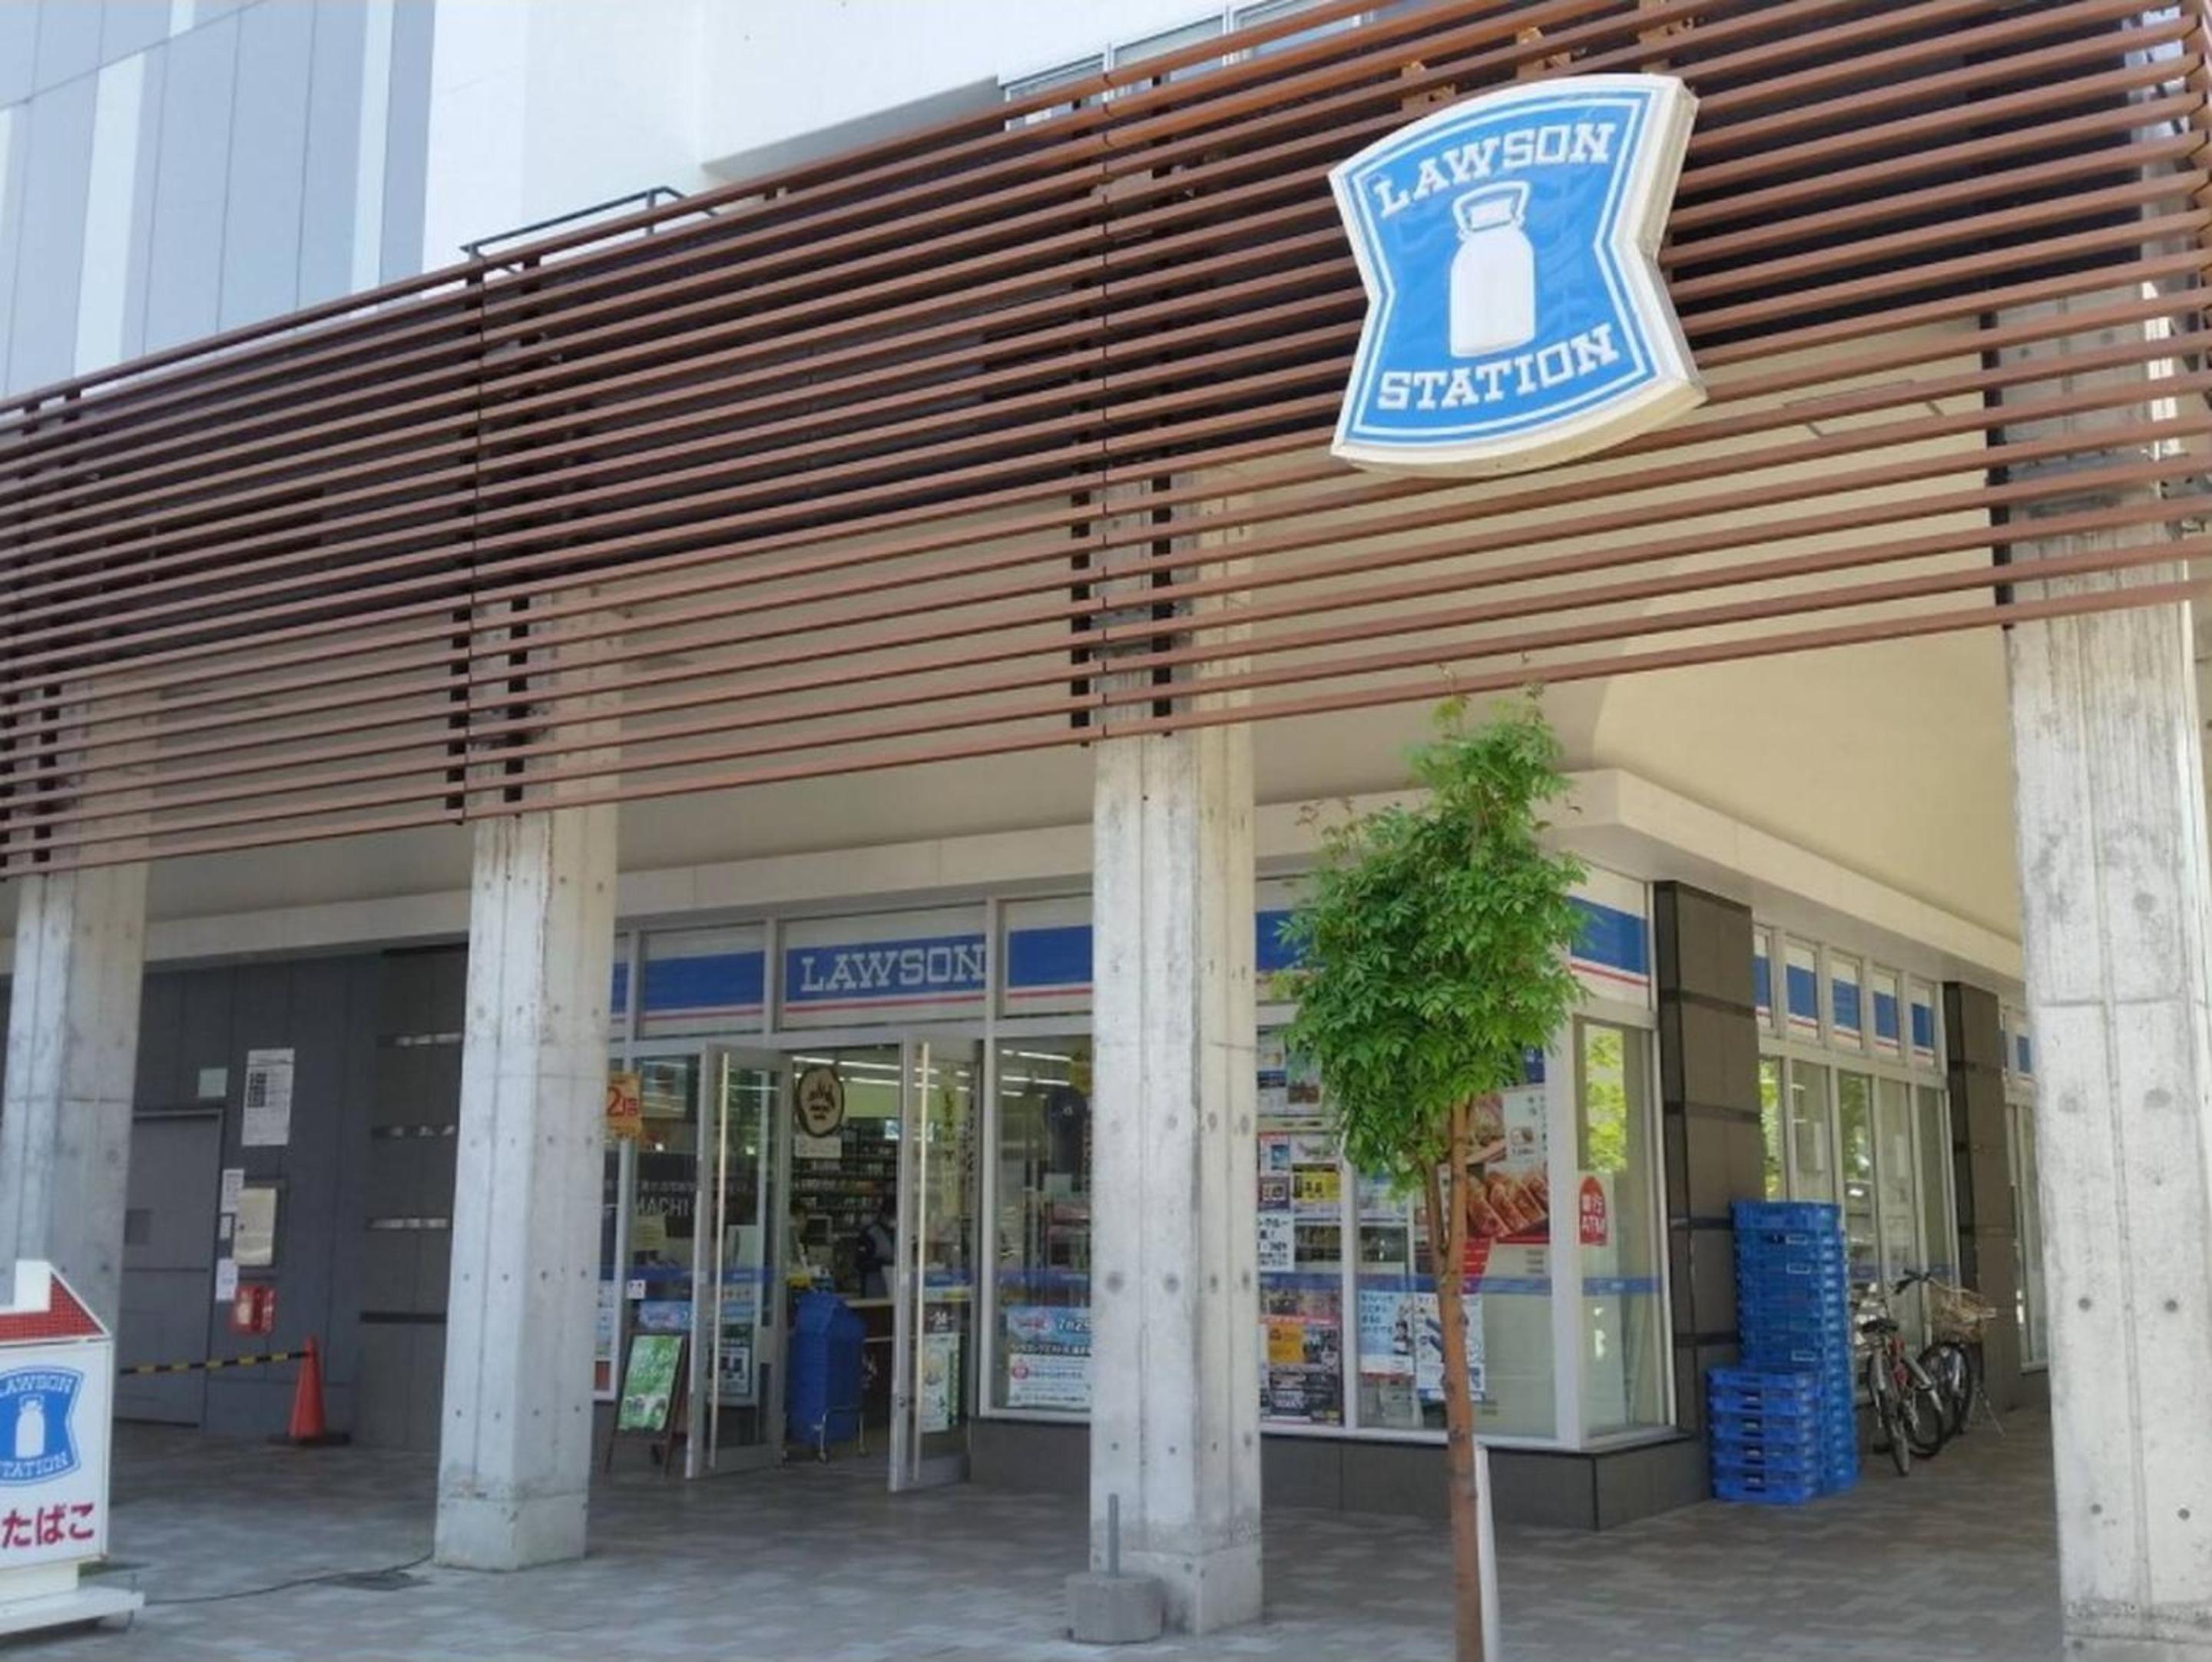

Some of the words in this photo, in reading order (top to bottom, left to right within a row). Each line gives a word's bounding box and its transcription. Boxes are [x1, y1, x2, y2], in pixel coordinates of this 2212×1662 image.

[1374, 123, 1616, 219] LAWSON
[1377, 324, 1618, 410] STATION
[800, 945, 985, 992] LAWSON
[2, 1503, 94, 1549] たばこ
